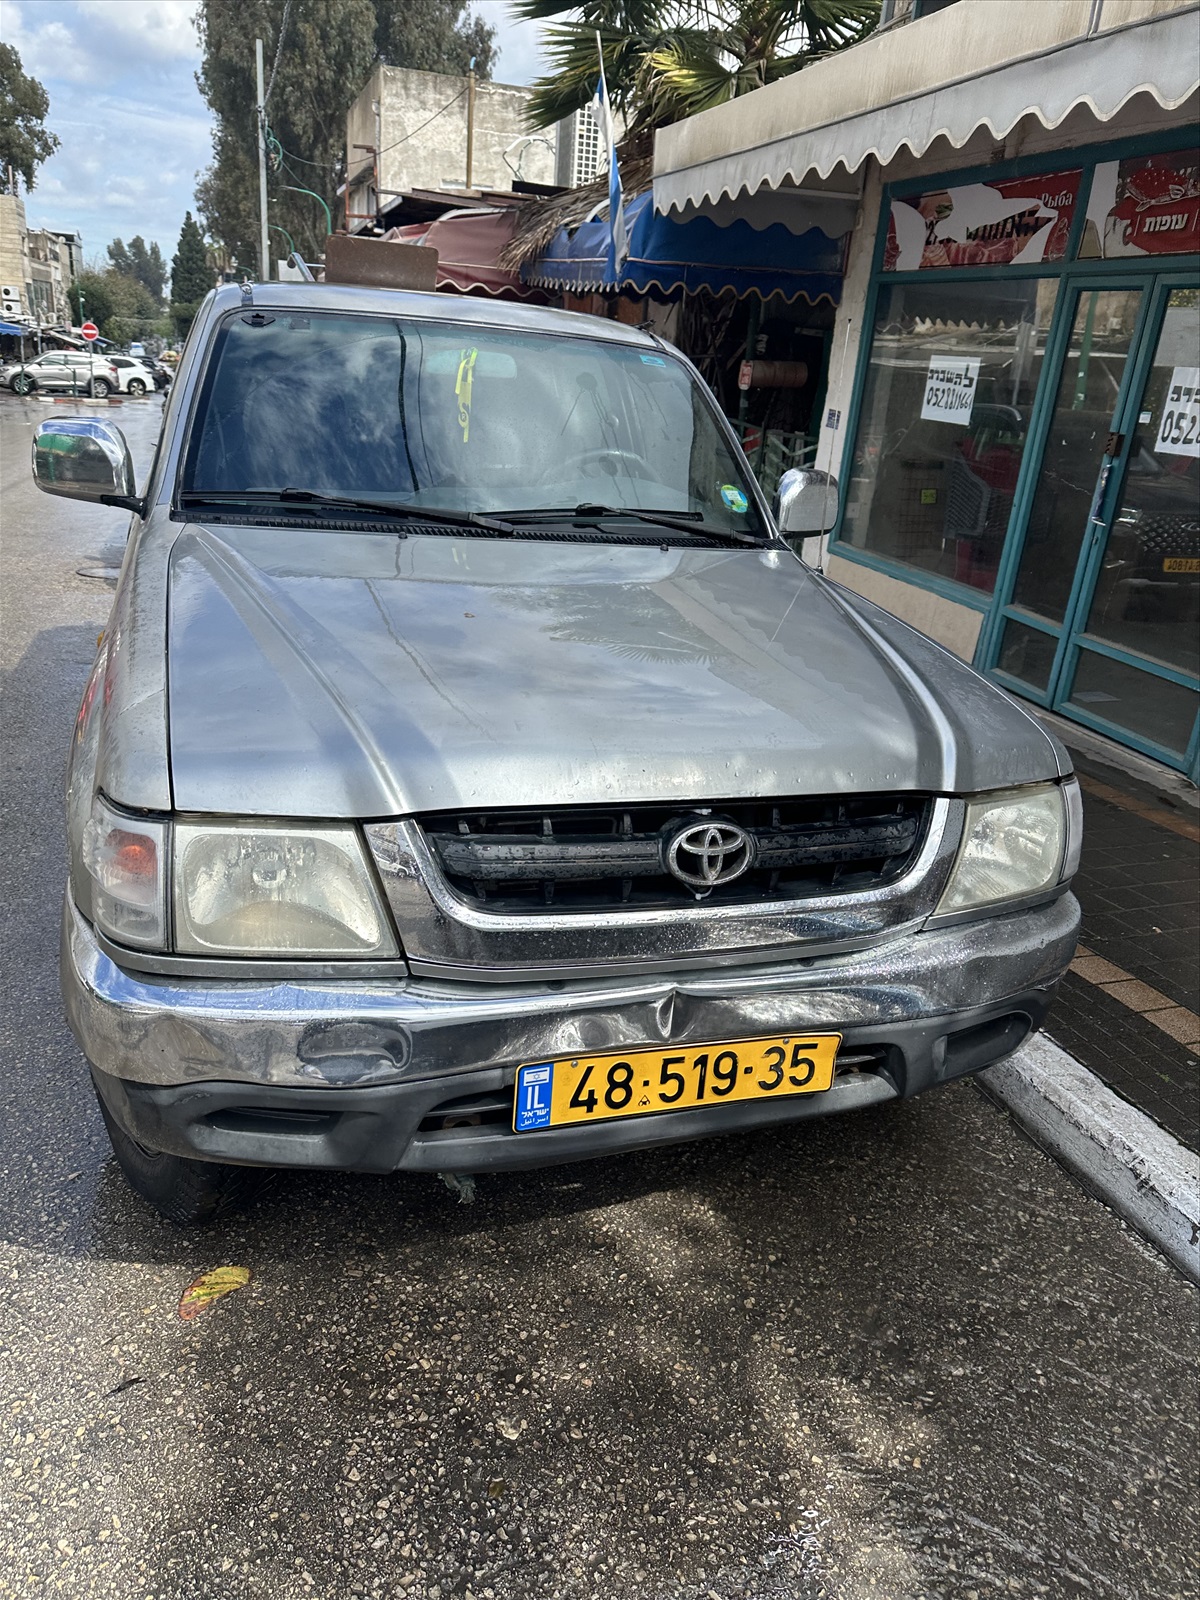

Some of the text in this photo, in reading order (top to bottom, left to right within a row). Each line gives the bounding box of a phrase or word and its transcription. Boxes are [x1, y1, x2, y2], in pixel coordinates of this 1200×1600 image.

[1041, 190, 1073, 208] Рыба
[1142, 213, 1189, 233] עופות
[526, 1085, 545, 1110] IL
[521, 1108, 550, 1119] ישראל
